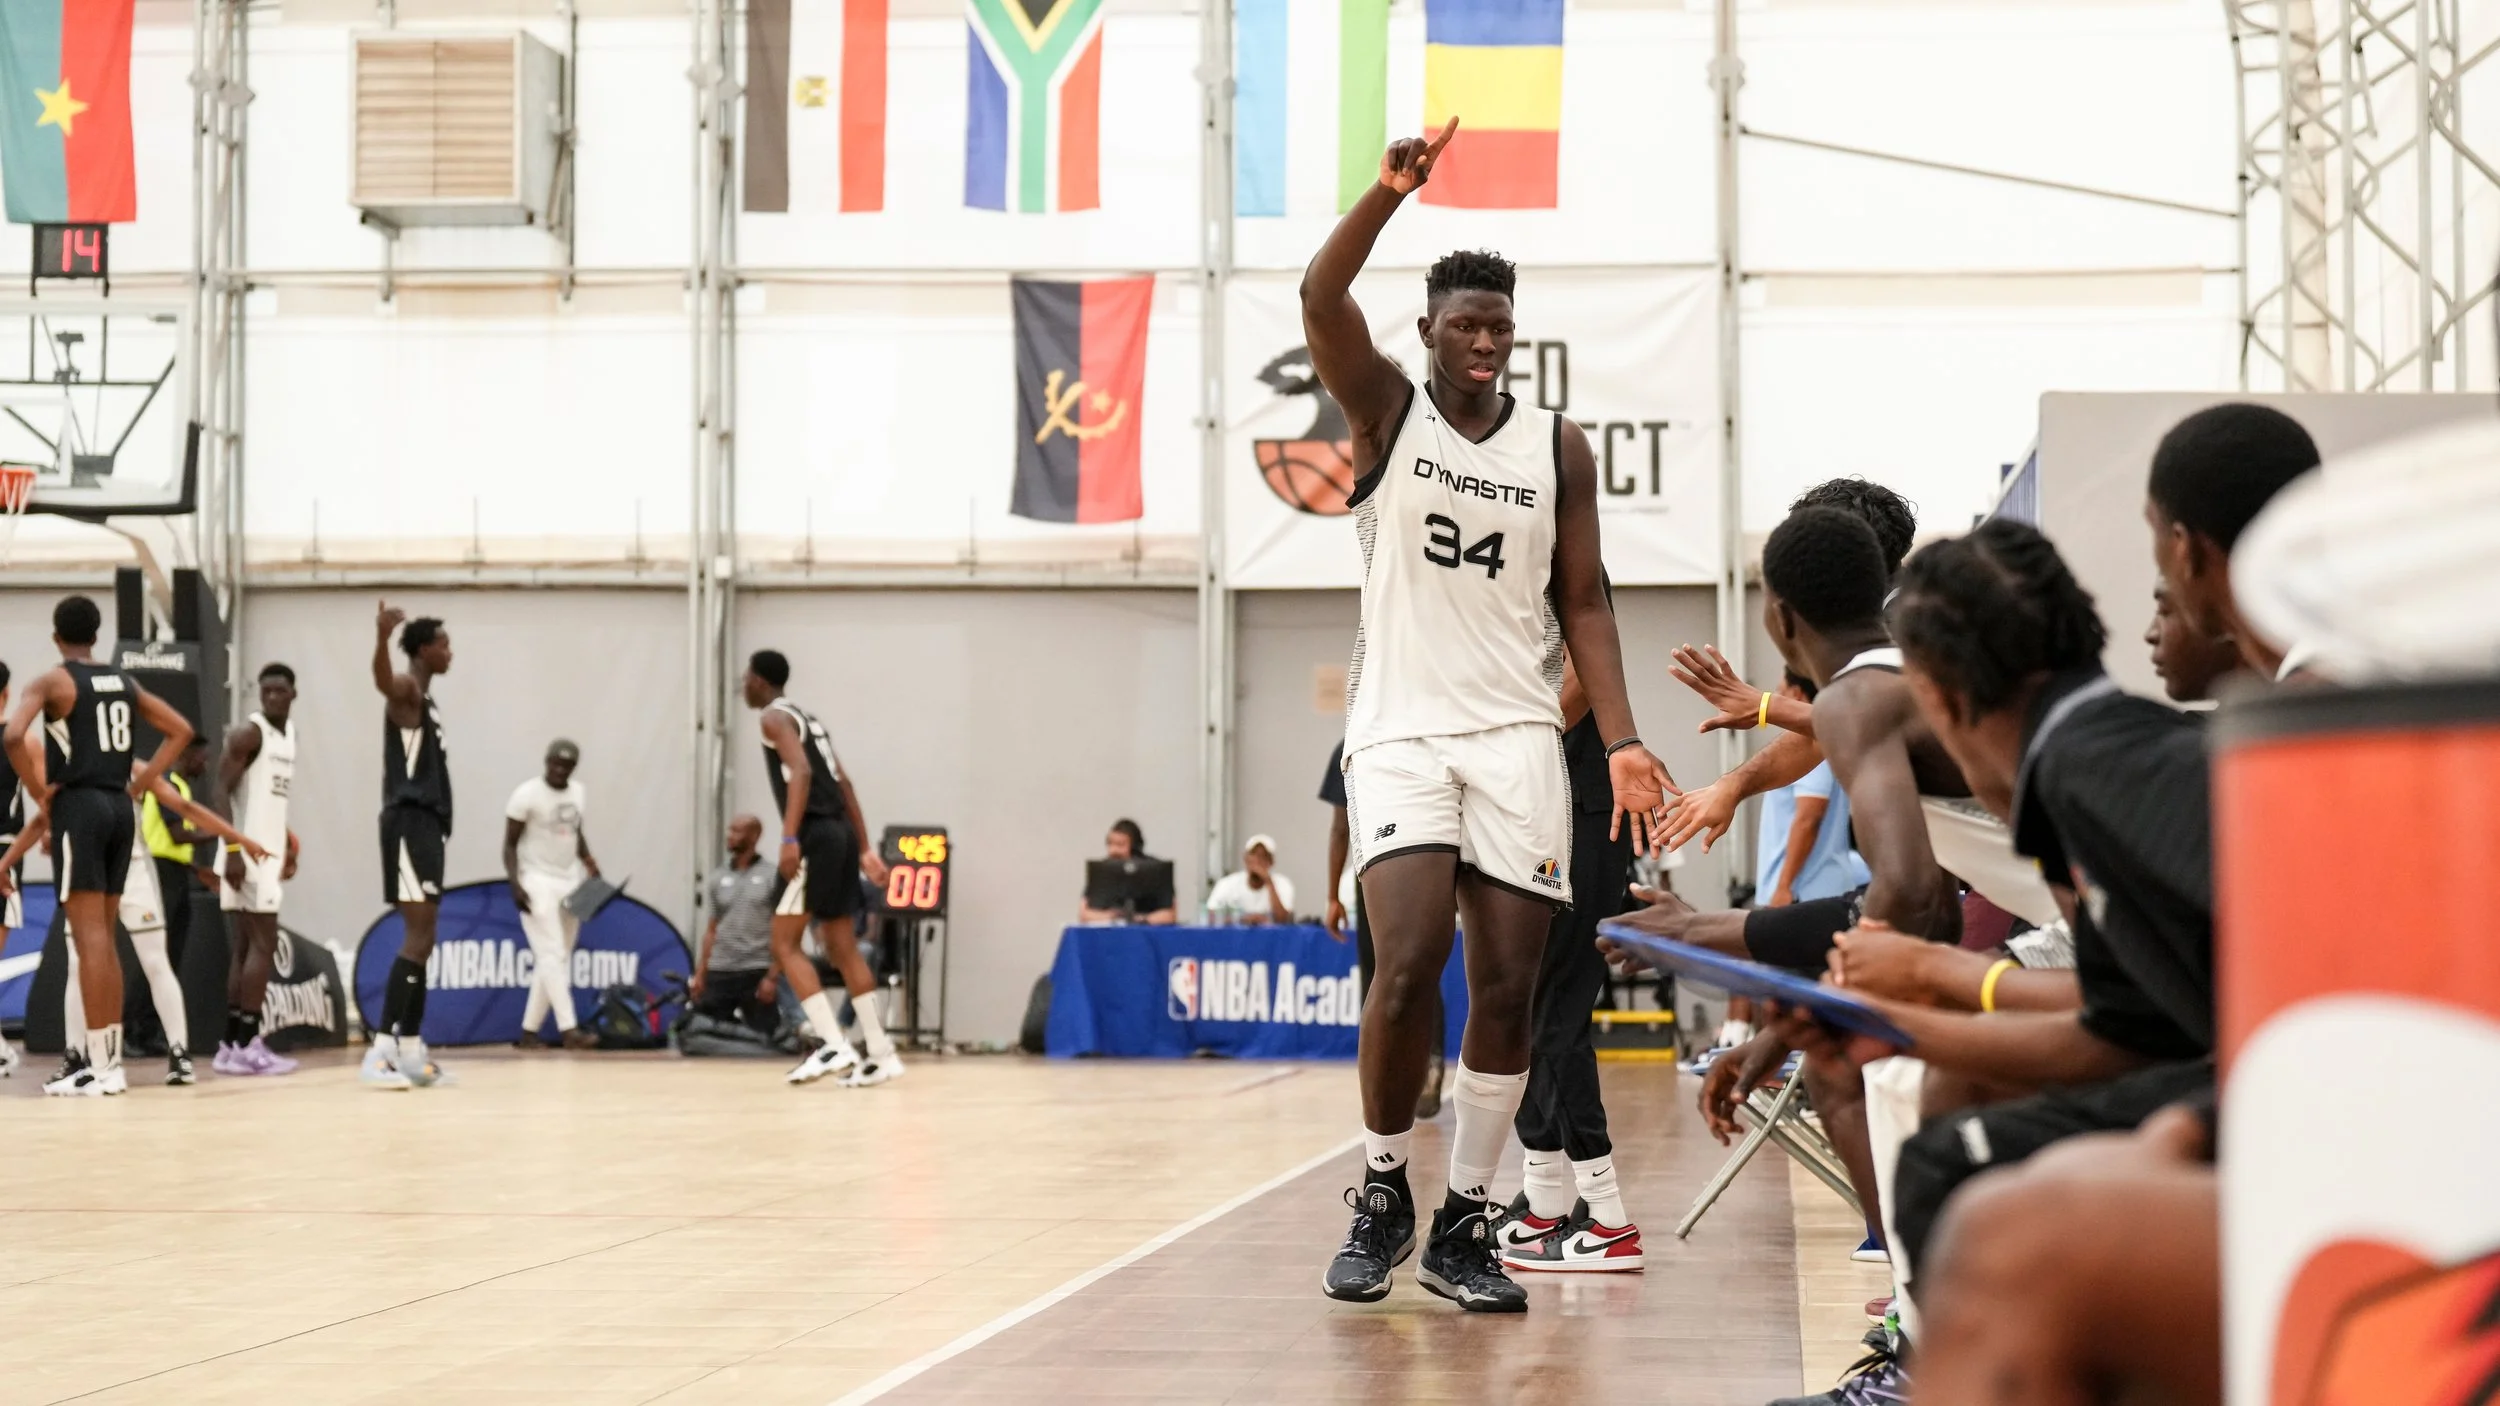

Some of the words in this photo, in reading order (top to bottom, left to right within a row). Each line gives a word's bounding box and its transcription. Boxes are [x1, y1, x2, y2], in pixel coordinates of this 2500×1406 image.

[61, 229, 100, 272] 14
[1413, 457, 1537, 509] DYNASTIE
[1423, 512, 1506, 580] 34
[96, 700, 131, 752] 18
[886, 865, 942, 908] 00
[1532, 874, 1562, 890] DYNASTIE
[1200, 959, 1270, 1023] NBA
